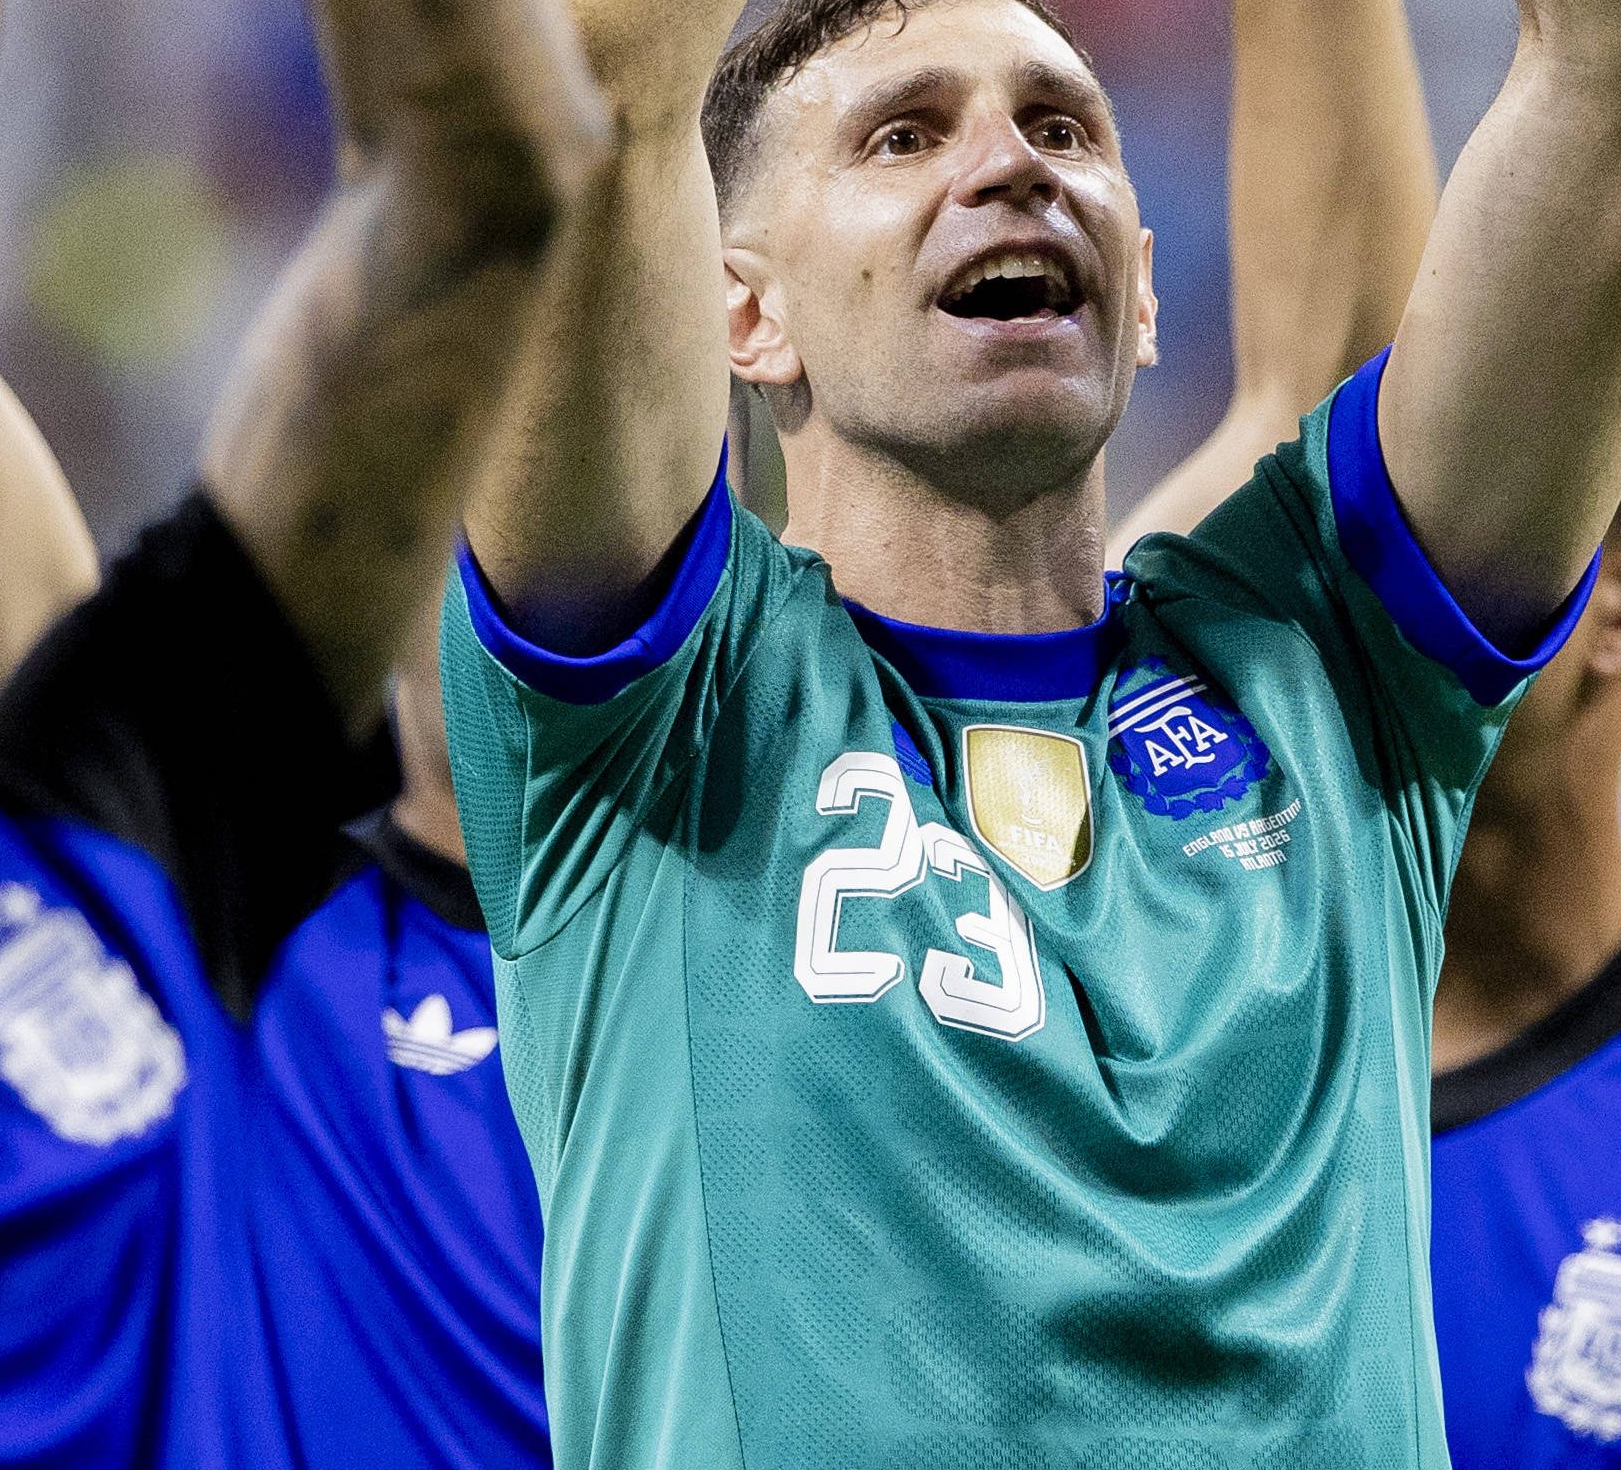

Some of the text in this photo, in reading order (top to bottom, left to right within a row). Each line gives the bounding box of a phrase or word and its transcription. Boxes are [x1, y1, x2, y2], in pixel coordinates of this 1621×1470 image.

[1133, 705, 1229, 777] AFA
[1009, 824, 1064, 855] FIFA
[1182, 827, 1235, 857] ENGLAND
[1233, 822, 1250, 839] VS
[1219, 829, 1291, 858] 15 JULY 2026
[1239, 849, 1287, 871] ATLANTA
[793, 751, 1046, 1043] 23
